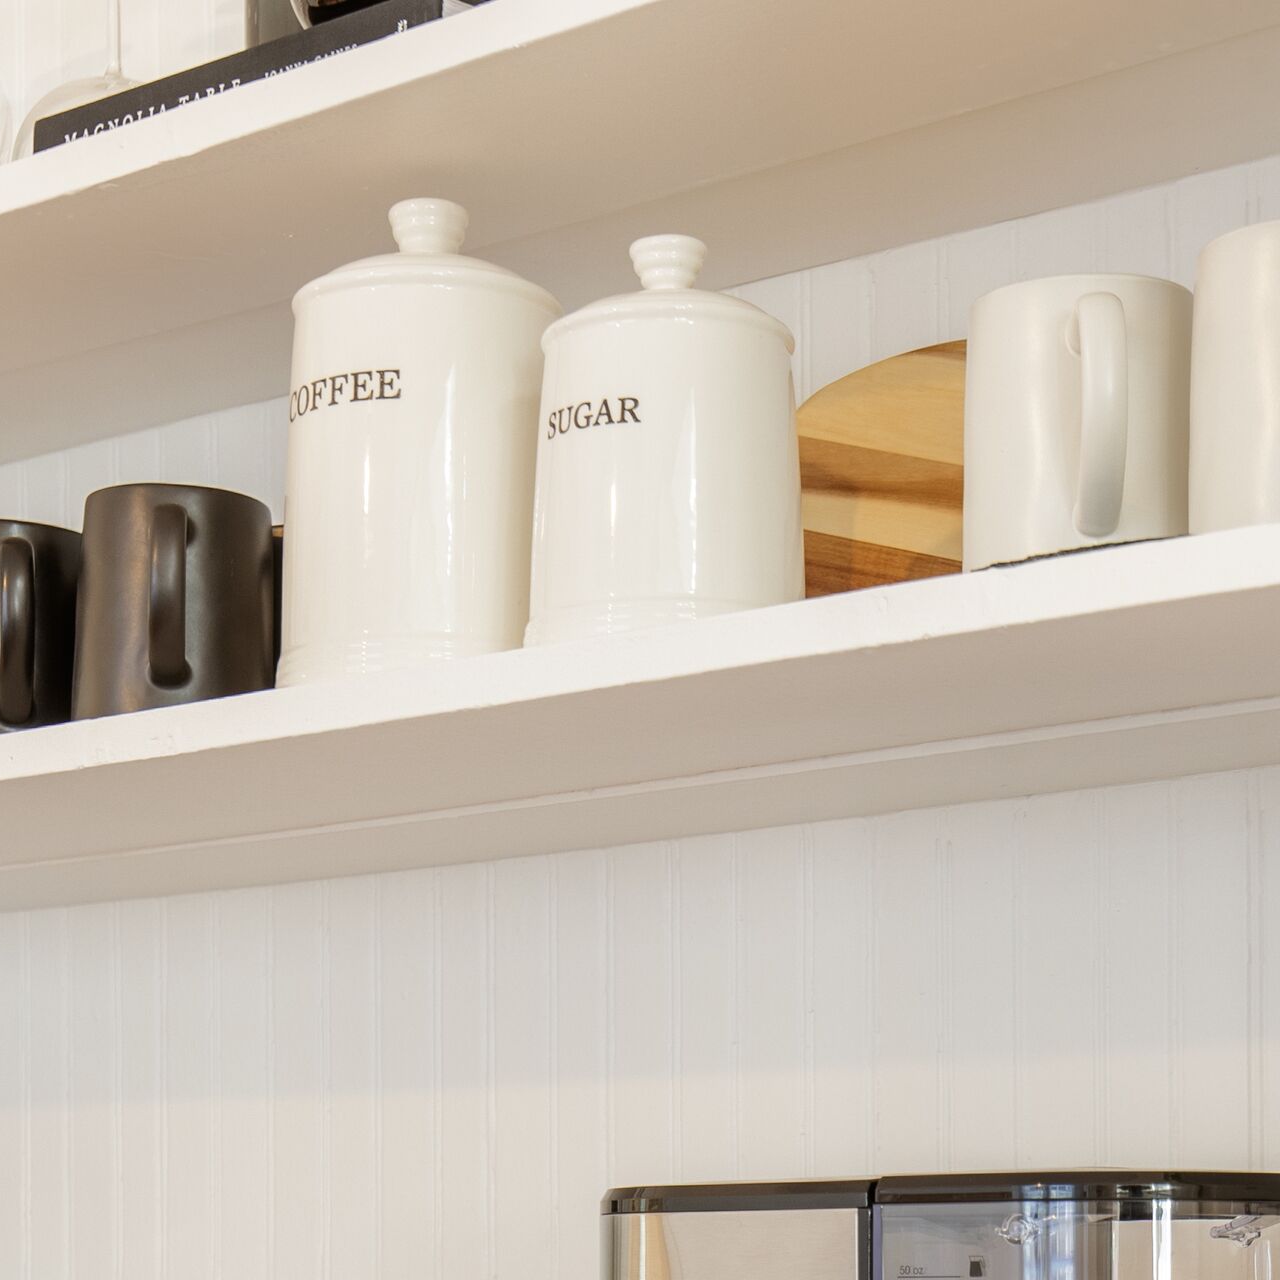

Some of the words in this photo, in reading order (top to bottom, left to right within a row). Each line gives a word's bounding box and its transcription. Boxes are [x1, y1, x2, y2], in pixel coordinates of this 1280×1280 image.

[289, 369, 402, 423] COFFEE
[547, 396, 642, 440] SUGAR
[899, 1265, 911, 1275] 50
